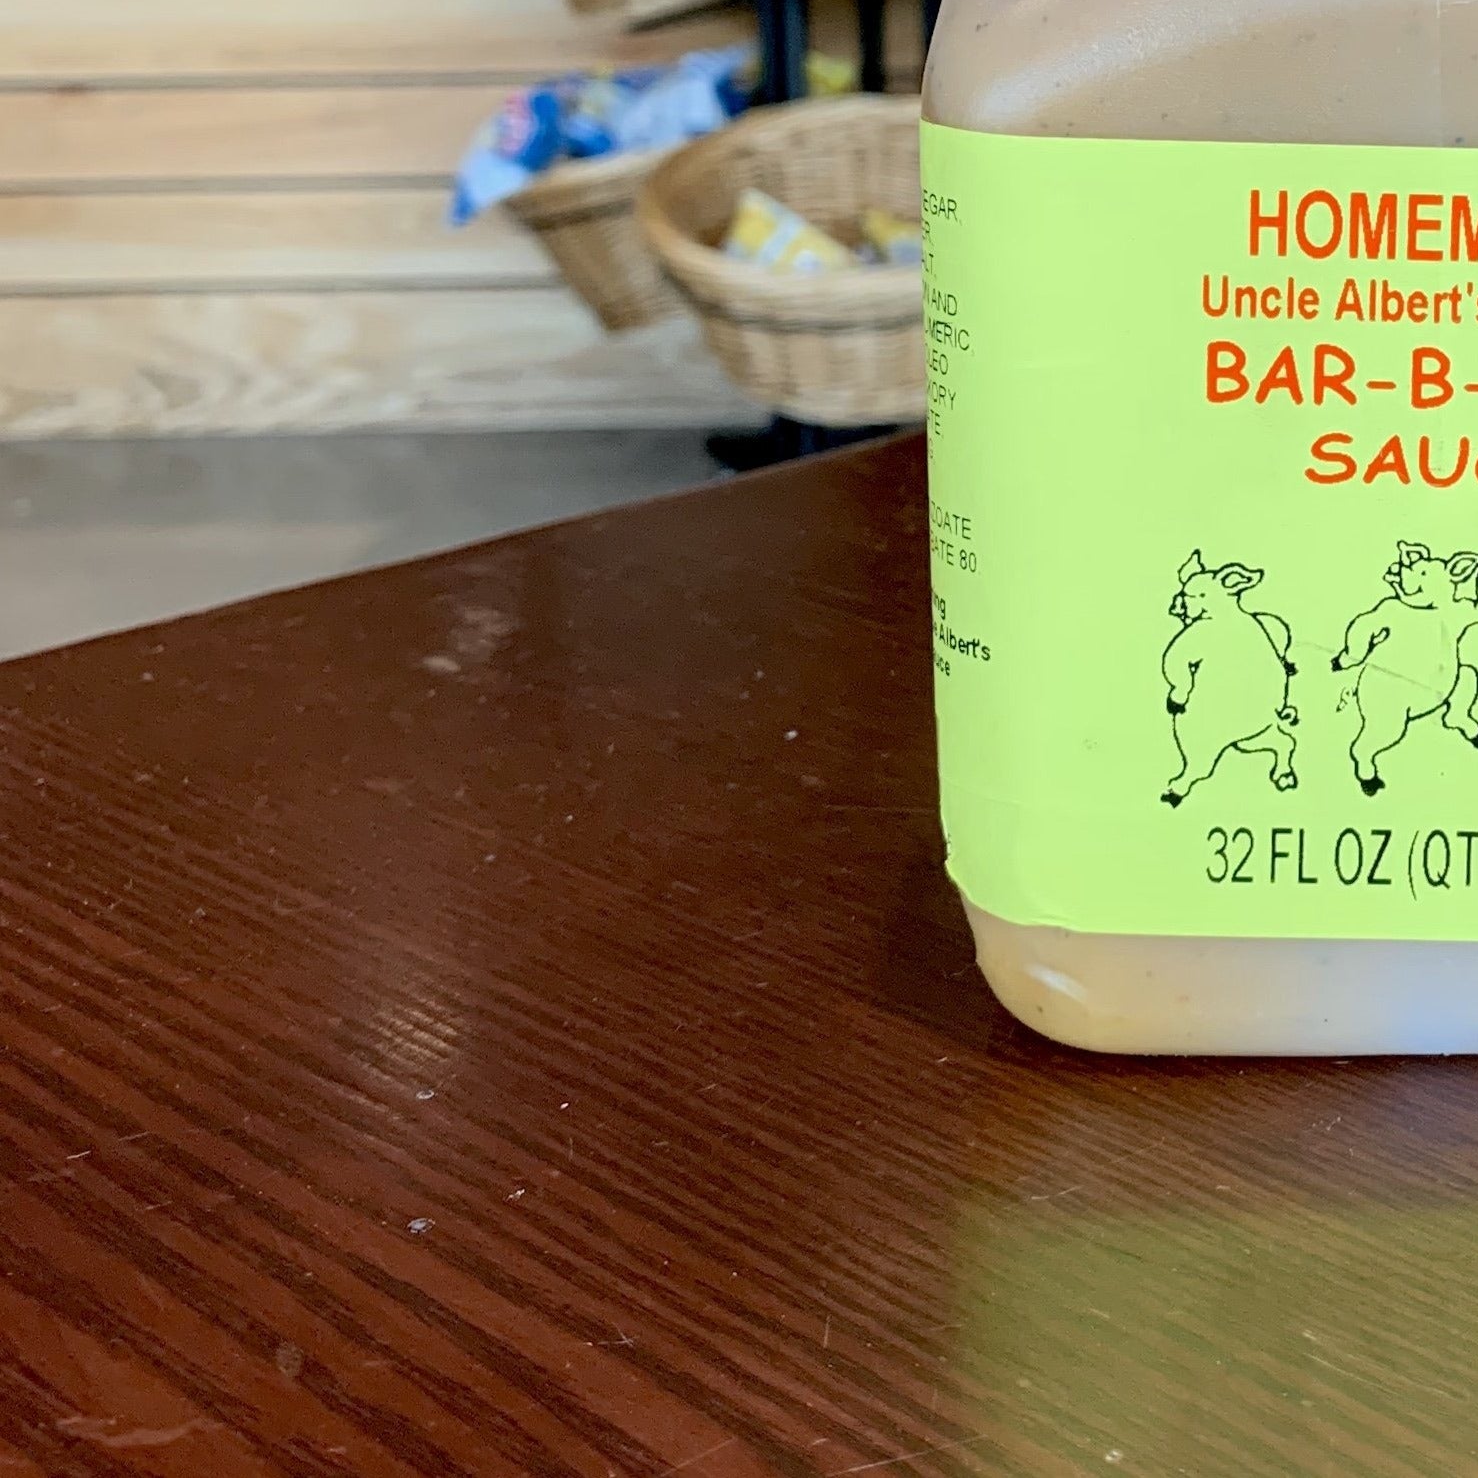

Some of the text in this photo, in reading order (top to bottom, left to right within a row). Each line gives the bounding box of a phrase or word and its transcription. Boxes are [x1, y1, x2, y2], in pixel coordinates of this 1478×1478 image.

[931, 288, 958, 317] AND
[1201, 274, 1320, 320] Uncle
[1206, 826, 1254, 884] 32
[1270, 828, 1318, 884] FL
[1334, 828, 1393, 886] OZ
